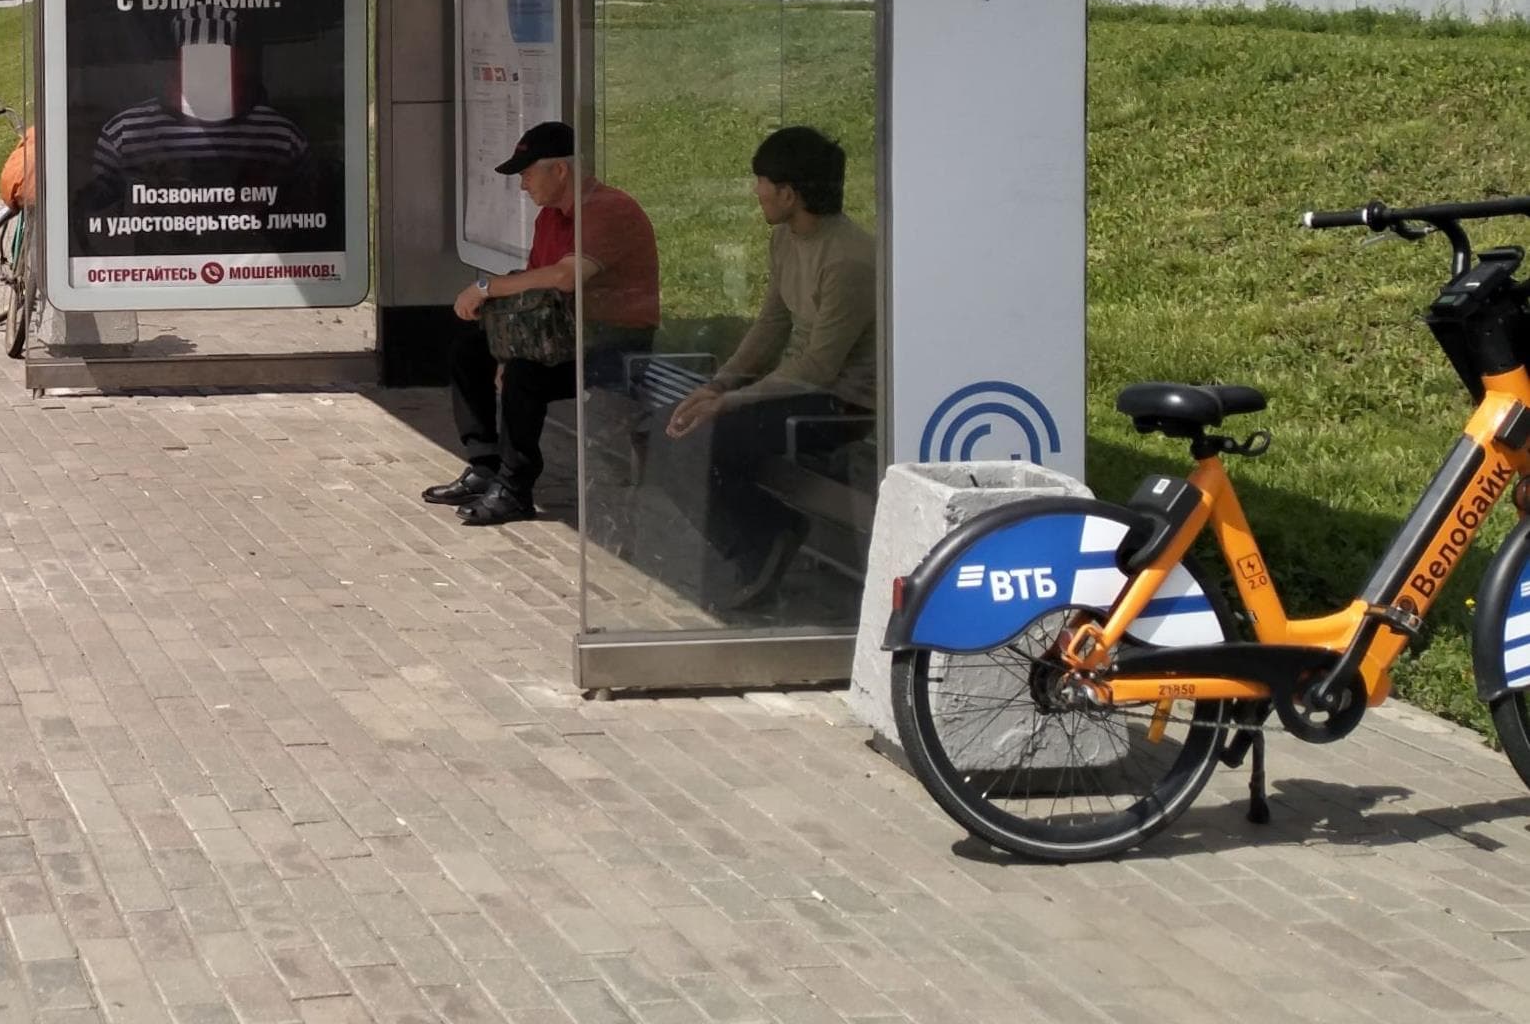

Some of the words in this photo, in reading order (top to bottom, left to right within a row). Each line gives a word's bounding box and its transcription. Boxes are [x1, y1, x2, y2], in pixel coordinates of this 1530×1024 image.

[132, 184, 236, 205] Позвоните
[240, 186, 278, 206] ему
[89, 217, 102, 233] и
[107, 214, 262, 237] удостоверьтесь
[266, 212, 327, 230] лично
[87, 266, 198, 283] ОСТЕРЕГАЙТЕСЬ
[229, 263, 336, 280] МОШЕННИКОВ!
[1410, 461, 1512, 599] Велобайк
[990, 567, 1057, 602] ВТБ
